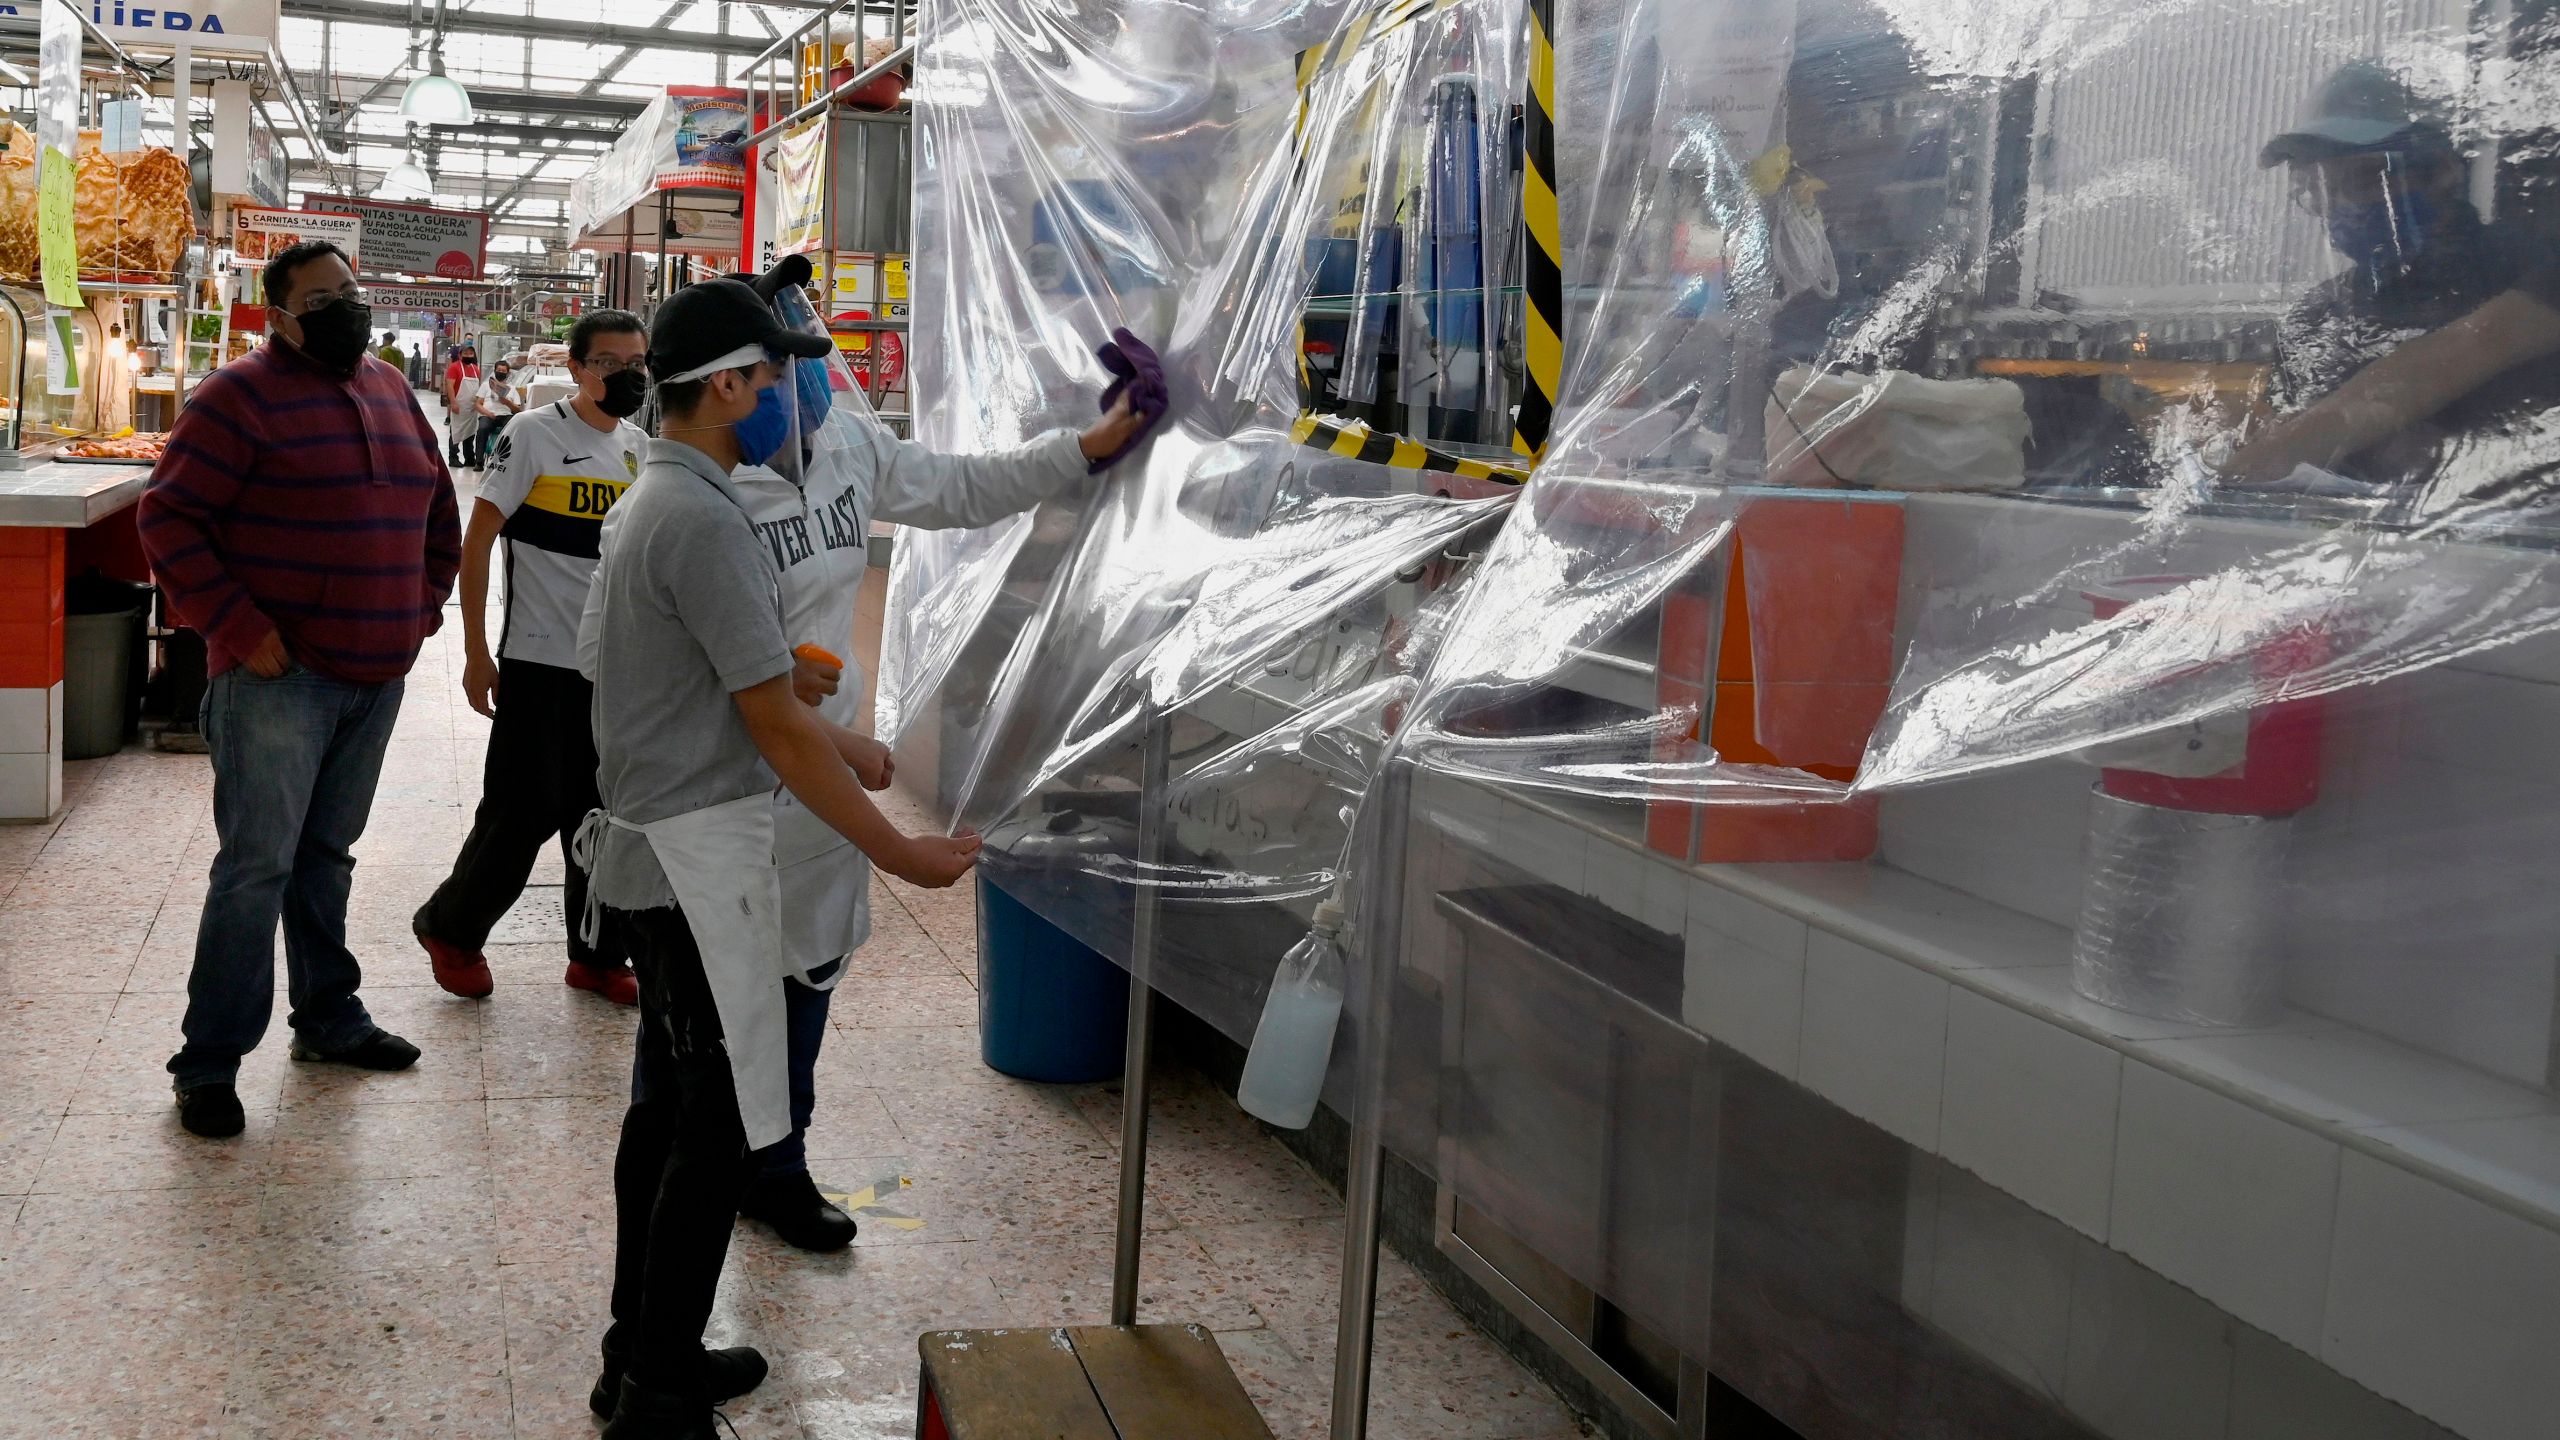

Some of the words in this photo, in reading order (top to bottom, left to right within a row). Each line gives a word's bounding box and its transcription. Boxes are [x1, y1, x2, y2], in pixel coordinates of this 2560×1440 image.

[253, 214, 299, 225] CARNITAS
[362, 220, 374, 228] SU
[375, 221, 411, 231] FAMOSA
[413, 225, 468, 238] ACHICALADA
[366, 227, 385, 236] CON
[387, 229, 441, 243] COCA-COLA)
[375, 288, 418, 298] COMEDOR
[420, 291, 459, 299] FAMILIAR
[374, 296, 400, 306] LOS
[814, 484, 864, 551] LAST
